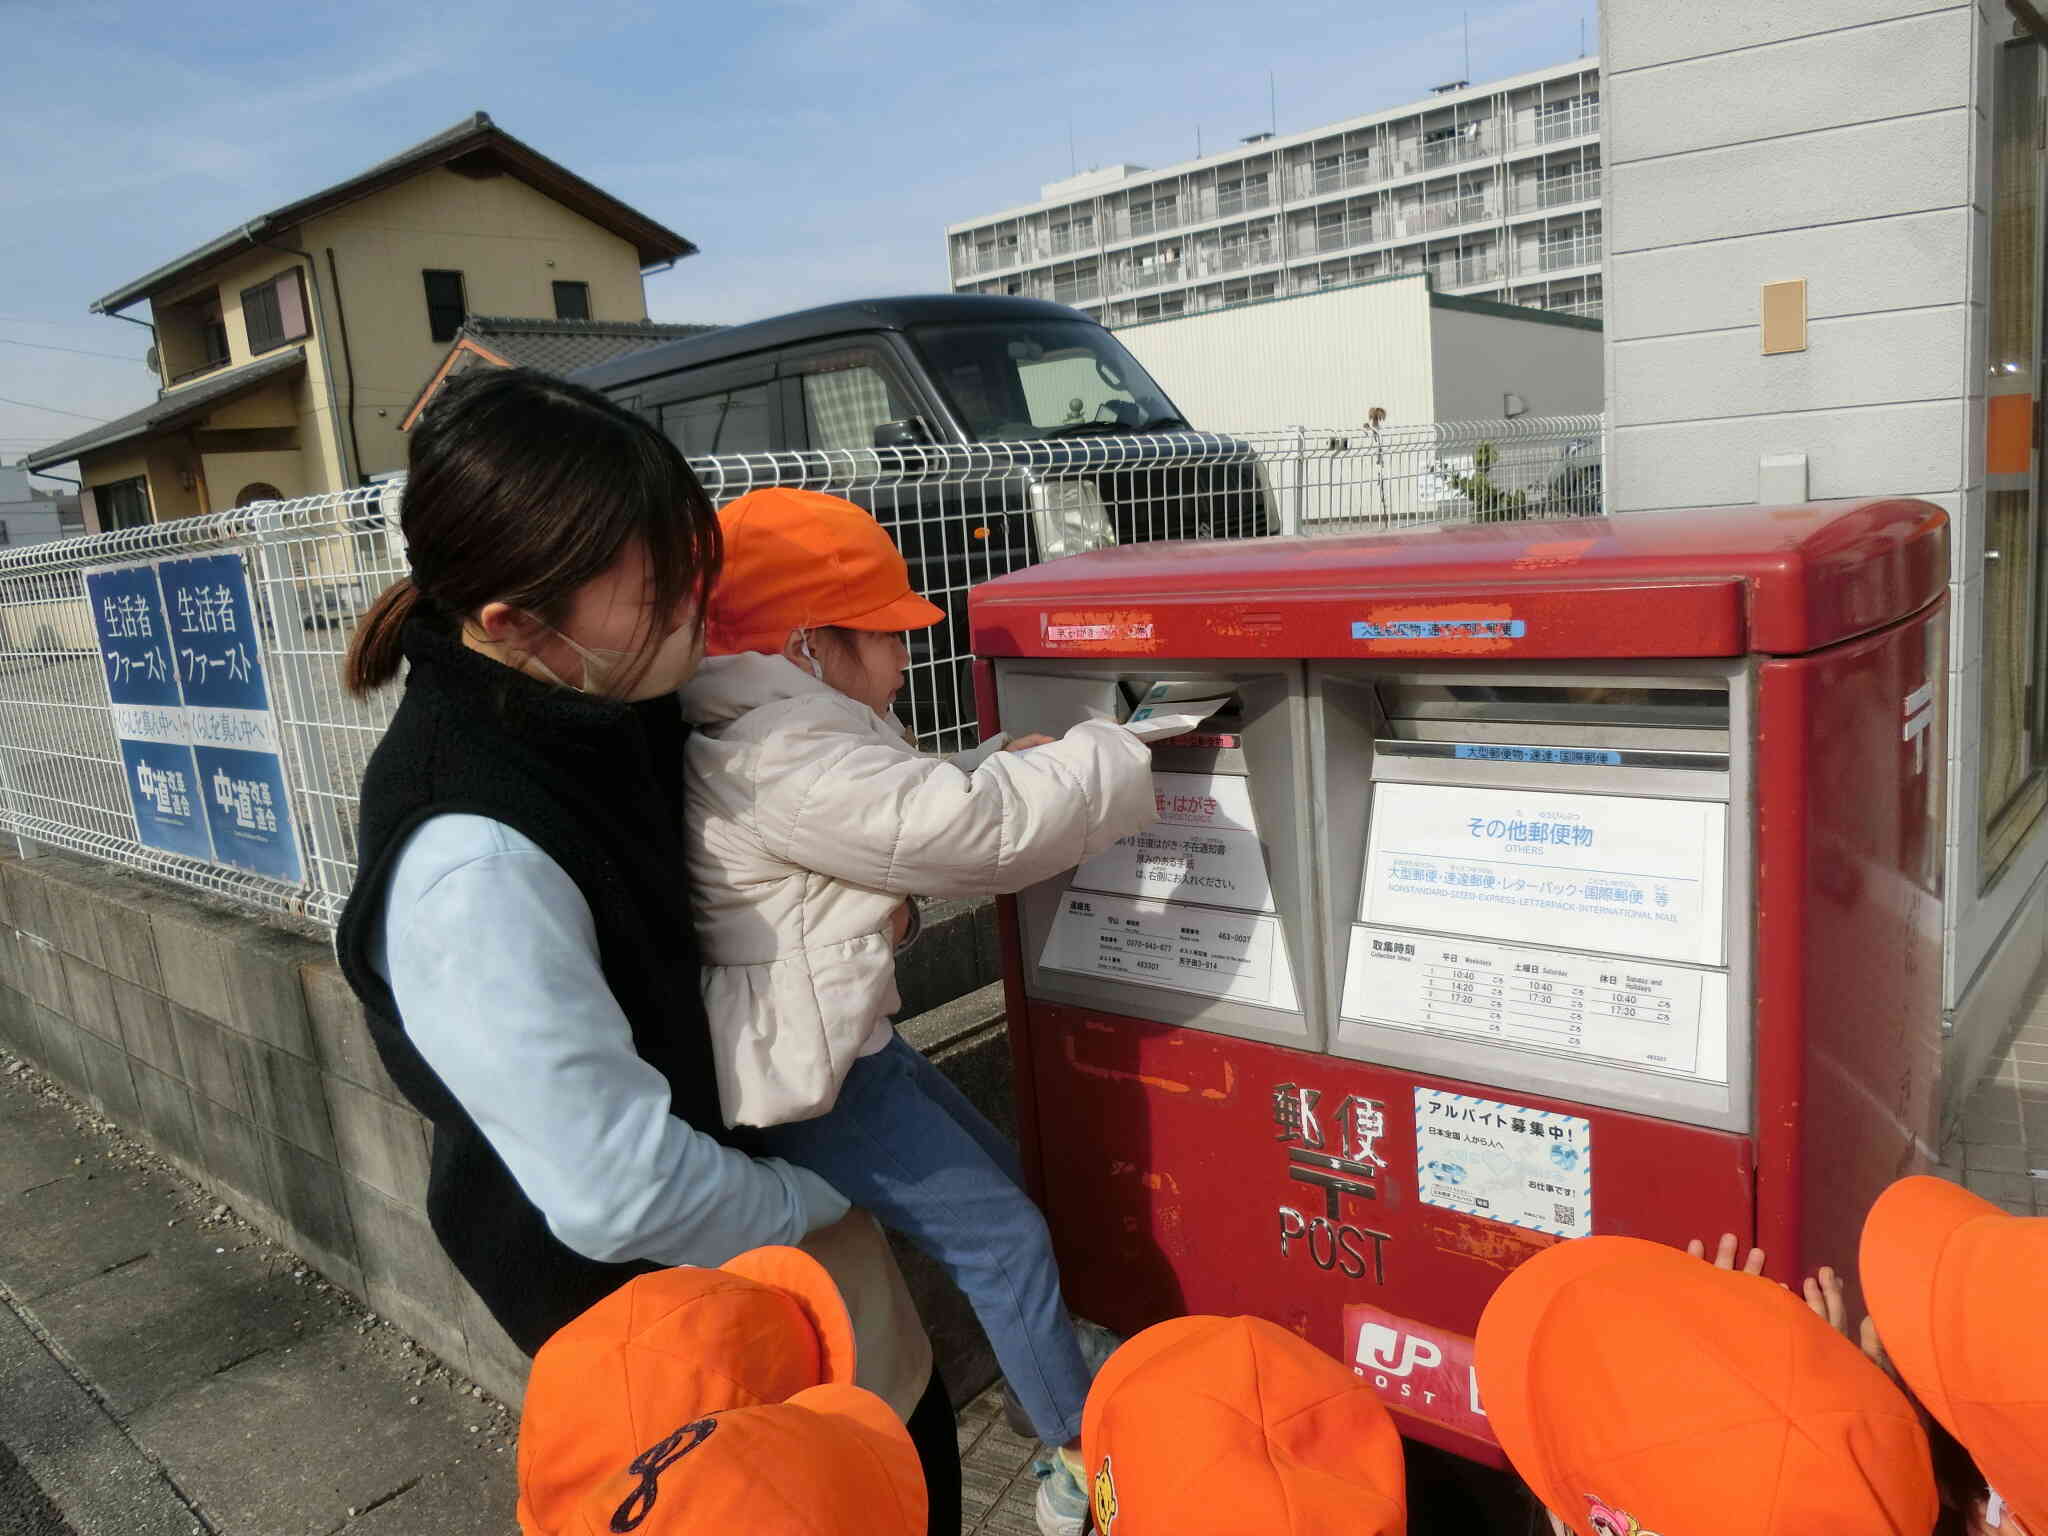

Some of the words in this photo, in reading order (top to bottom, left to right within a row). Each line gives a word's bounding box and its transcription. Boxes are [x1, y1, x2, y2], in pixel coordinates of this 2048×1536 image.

[104, 594, 152, 638] 生活者
[178, 584, 236, 633] 生活者
[108, 645, 167, 684] ファースト
[181, 642, 251, 685] ファースト
[1467, 817, 1594, 848] その他郵便物
[1504, 843, 1545, 857] OTHERS
[1372, 939, 1415, 955] 取集時刻
[1442, 952, 1457, 963] 平日
[1452, 969, 1474, 981] 10:40
[1515, 962, 1539, 975] 土曜日
[1599, 973, 1617, 985] 休日
[1452, 981, 1474, 992] 14:20
[1529, 980, 1553, 992] 10:40
[1528, 991, 1552, 1004] 17:30
[1612, 992, 1637, 1005] 10:40
[1271, 1082, 1389, 1169] 郵便
[1428, 1100, 1574, 1143] アルバイト募集中!
[1428, 1126, 1461, 1141] 日本全国
[1463, 1134, 1505, 1151] 人から人へ
[1528, 1180, 1576, 1199] お仕事です!
[1278, 1204, 1392, 1287] POST
[1355, 1322, 1442, 1377] JP
[1353, 1366, 1437, 1404] POST
